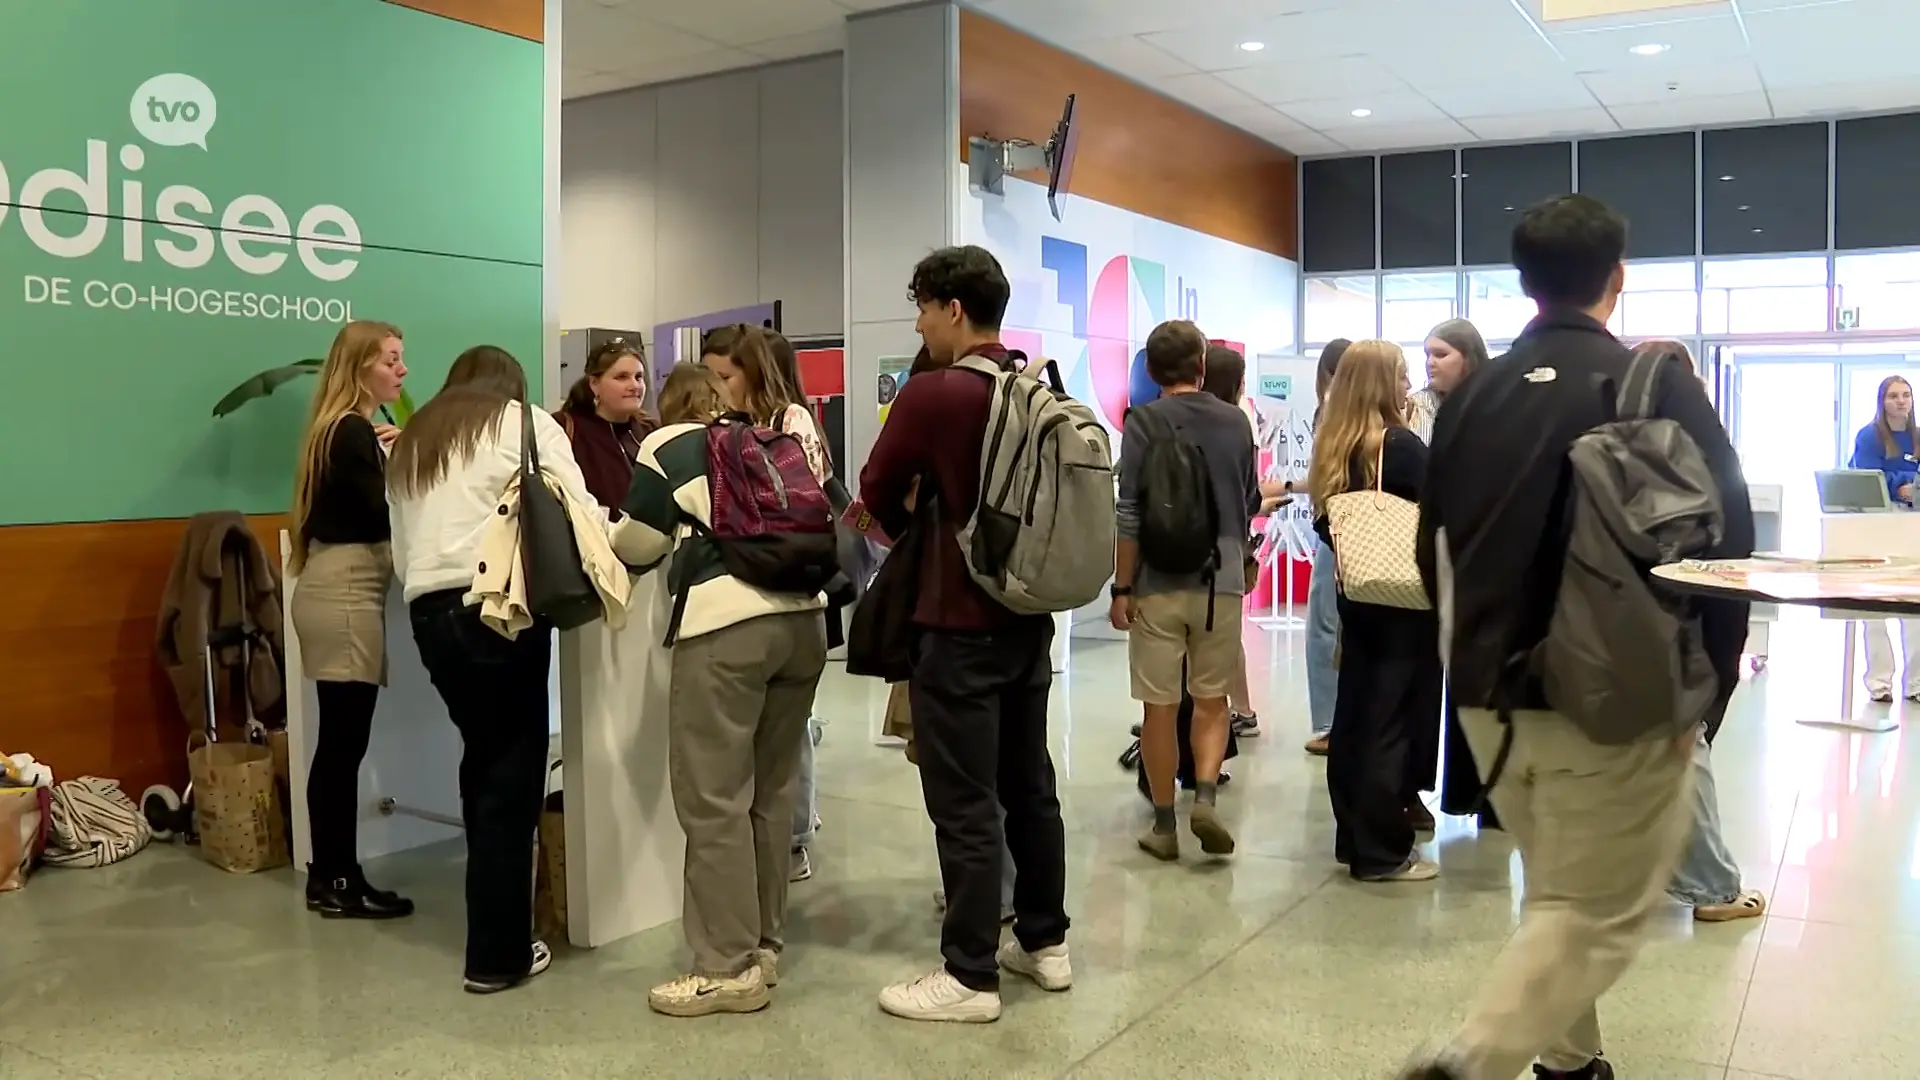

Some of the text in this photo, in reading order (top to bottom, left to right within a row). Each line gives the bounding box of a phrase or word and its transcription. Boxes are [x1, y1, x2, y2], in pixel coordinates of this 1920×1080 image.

[0, 138, 363, 282] disee
[24, 274, 356, 324] DE CO-HOGESCHOOL
